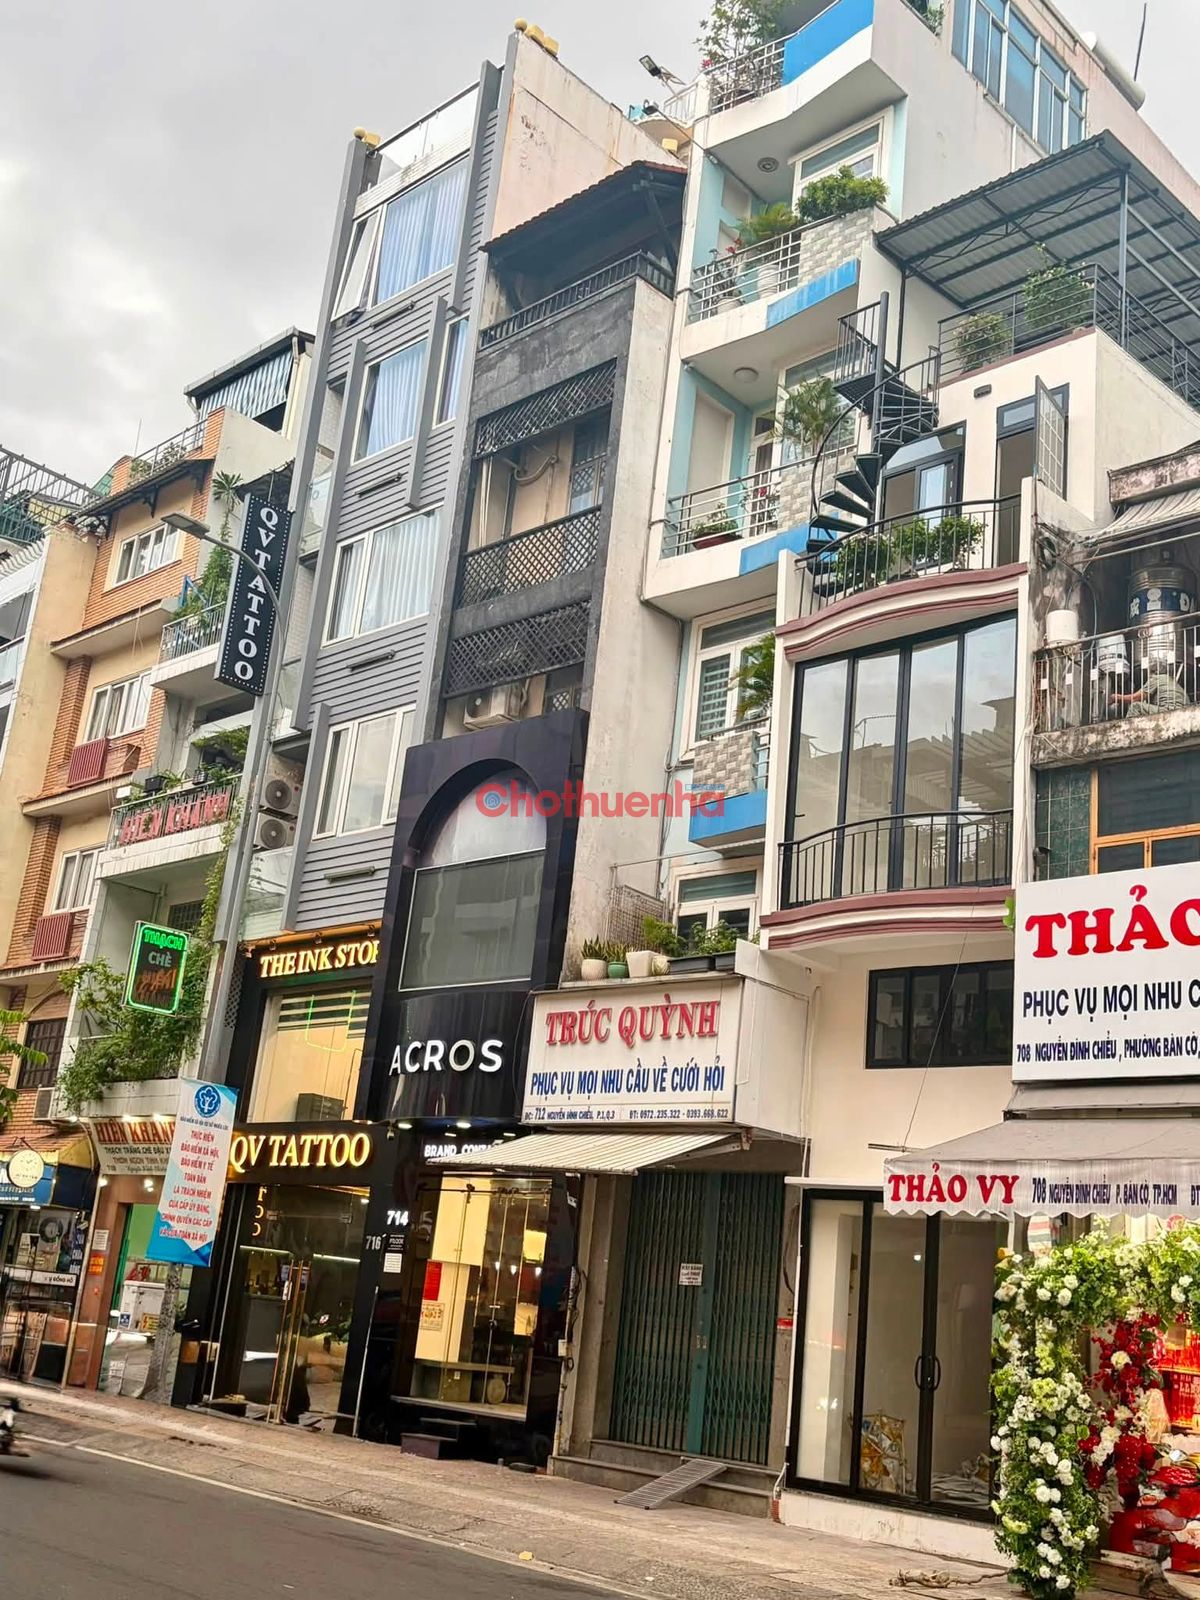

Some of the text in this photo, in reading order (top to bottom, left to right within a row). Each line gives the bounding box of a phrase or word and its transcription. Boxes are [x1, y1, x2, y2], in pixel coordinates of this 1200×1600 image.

[143, 929, 184, 950] THẠCH
[148, 951, 173, 968] CHÈ
[260, 952, 297, 978] THE
[296, 946, 334, 974] INK
[1023, 989, 1069, 1025] PHỤC
[1074, 987, 1097, 1022] VỤ
[1103, 984, 1138, 1020] MỌI
[1144, 981, 1182, 1011] NHU
[545, 993, 720, 1049] TRÚC QUỲNH
[388, 1039, 504, 1075] ACROS
[1016, 1044, 1031, 1062] 708
[1069, 1038, 1090, 1060] ĐÌNH
[1124, 1034, 1161, 1058] PHƯỜNG
[1163, 1033, 1183, 1057] BÀN
[530, 1055, 725, 1101] PHỤC VỤ MỌI NHU CẦU VỀ CƯỚI HỎI
[535, 1107, 546, 1120] 712
[229, 1133, 371, 1173] QV TATTOO
[888, 1162, 968, 1202] THẢO
[976, 1174, 1020, 1204] VY
[1032, 1177, 1047, 1203] 708
[1075, 1180, 1091, 1204] ĐÌNH
[1153, 1184, 1177, 1205] TP.HCM
[387, 1211, 409, 1226] 714
[366, 1236, 381, 1250] 716
